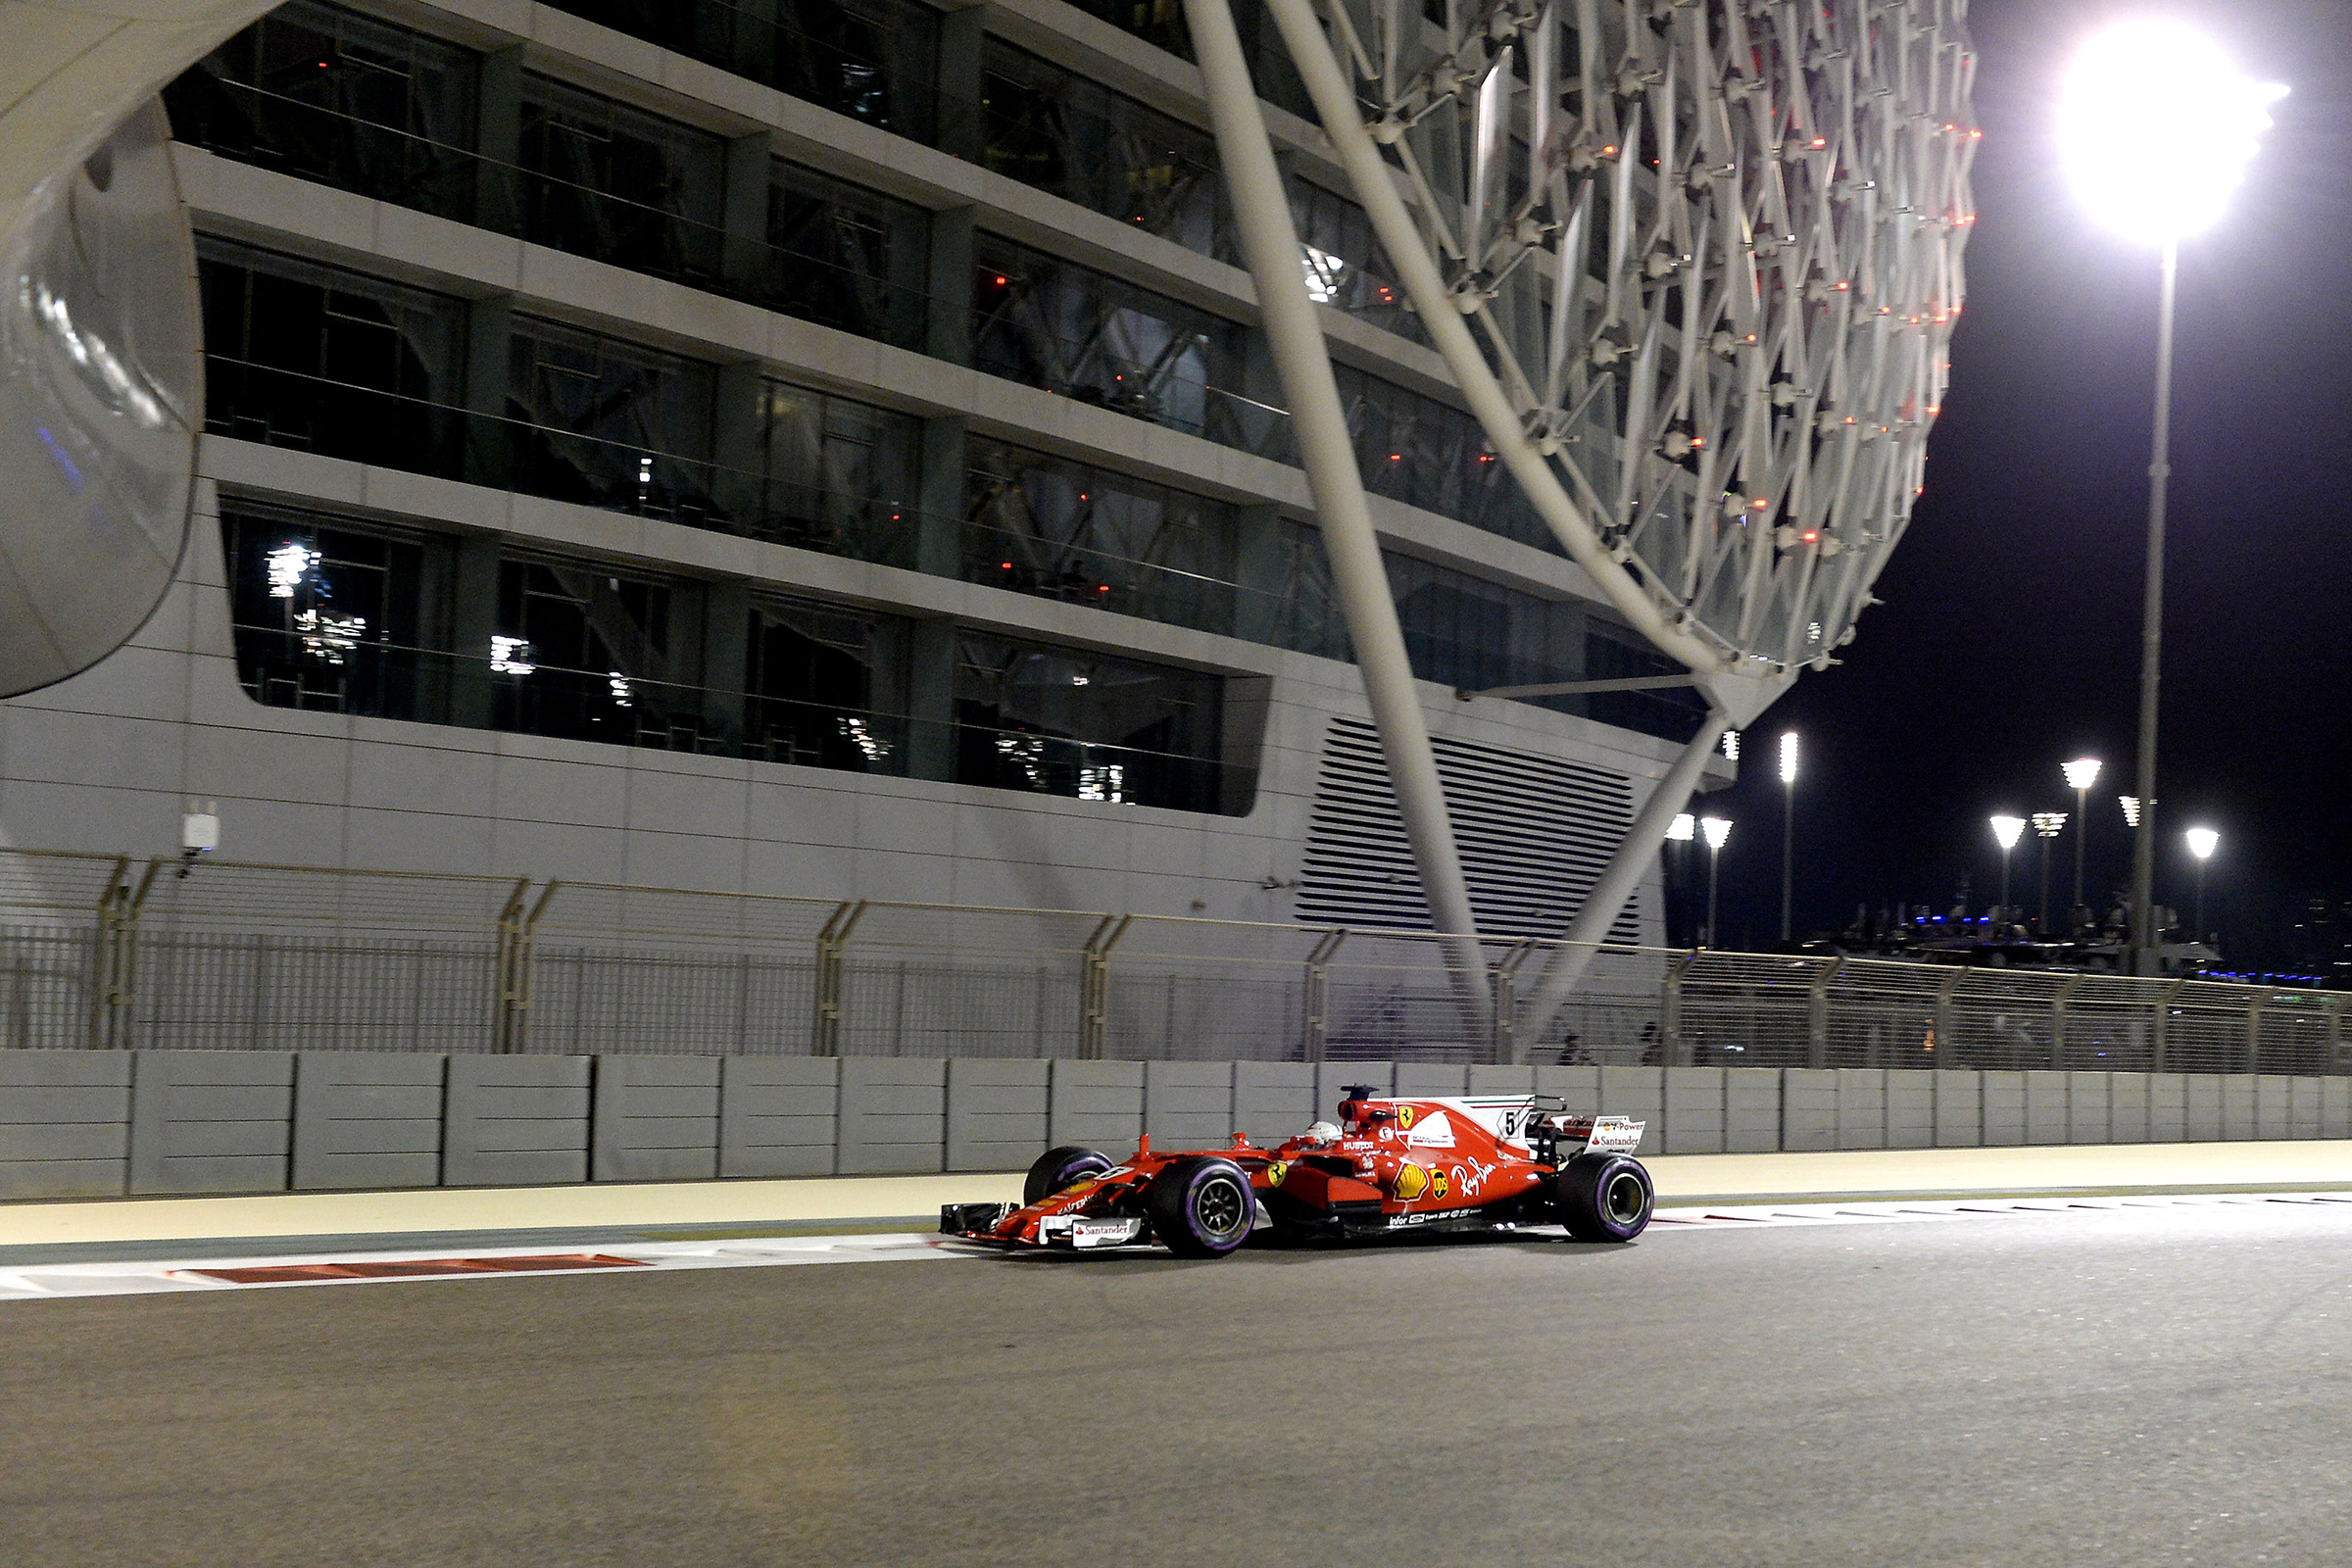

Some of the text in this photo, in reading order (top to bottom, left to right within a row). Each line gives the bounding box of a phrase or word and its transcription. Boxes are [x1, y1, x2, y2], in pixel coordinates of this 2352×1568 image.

[1505, 1111, 1515, 1136] 5
[1600, 1136, 1639, 1146] Santander
[1434, 1177, 1447, 1196] ups
[1085, 1223, 1128, 1235] Santander
